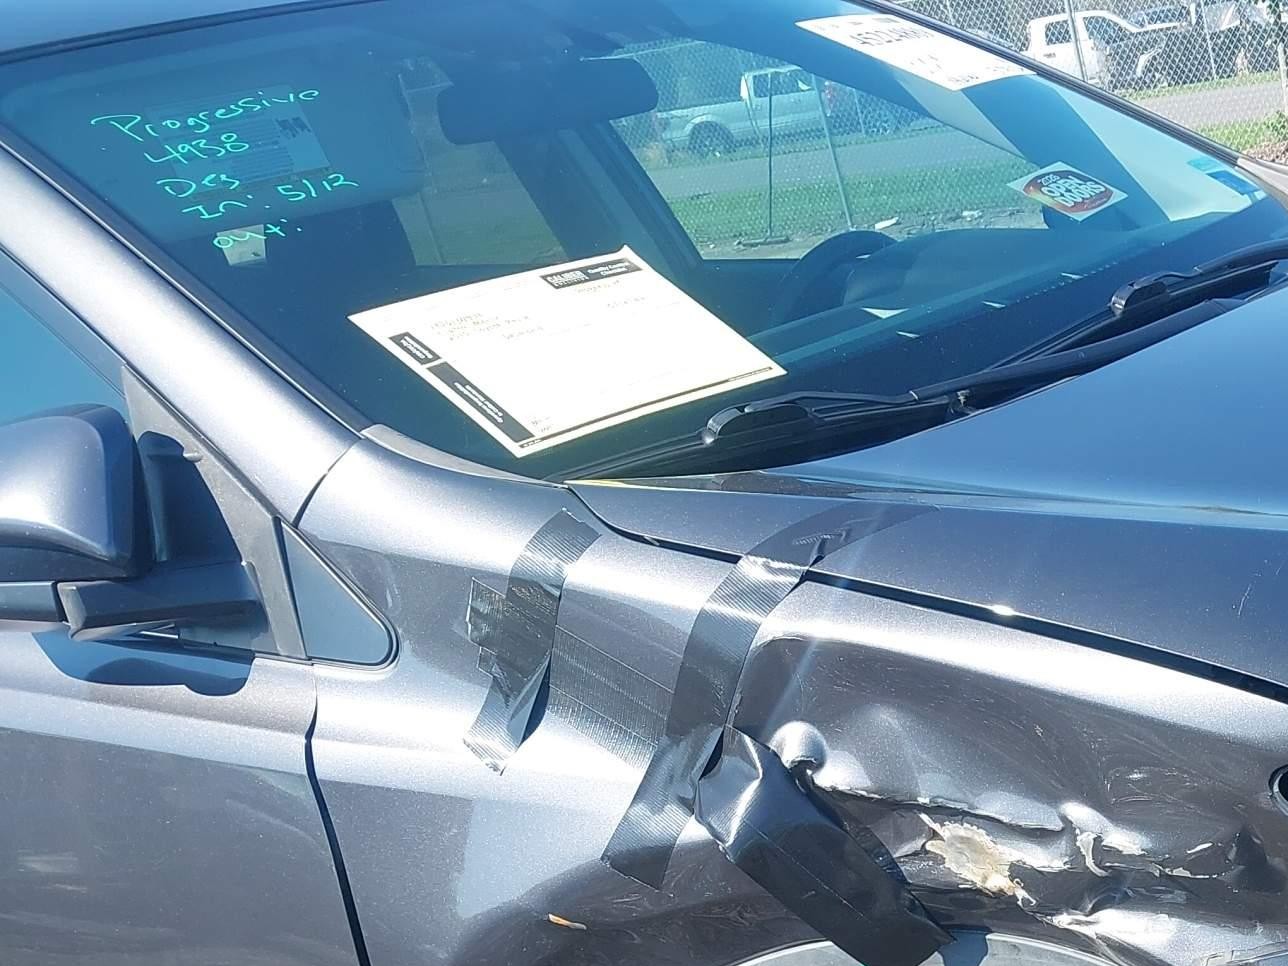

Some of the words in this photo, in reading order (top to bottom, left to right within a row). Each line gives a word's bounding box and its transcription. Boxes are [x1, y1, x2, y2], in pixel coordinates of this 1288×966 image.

[90, 88, 320, 142] Progressive
[144, 133, 249, 164] 4938
[276, 173, 360, 201] 5/12
[1041, 175, 1085, 197] OPEN
[1053, 182, 1105, 208] DOORS
